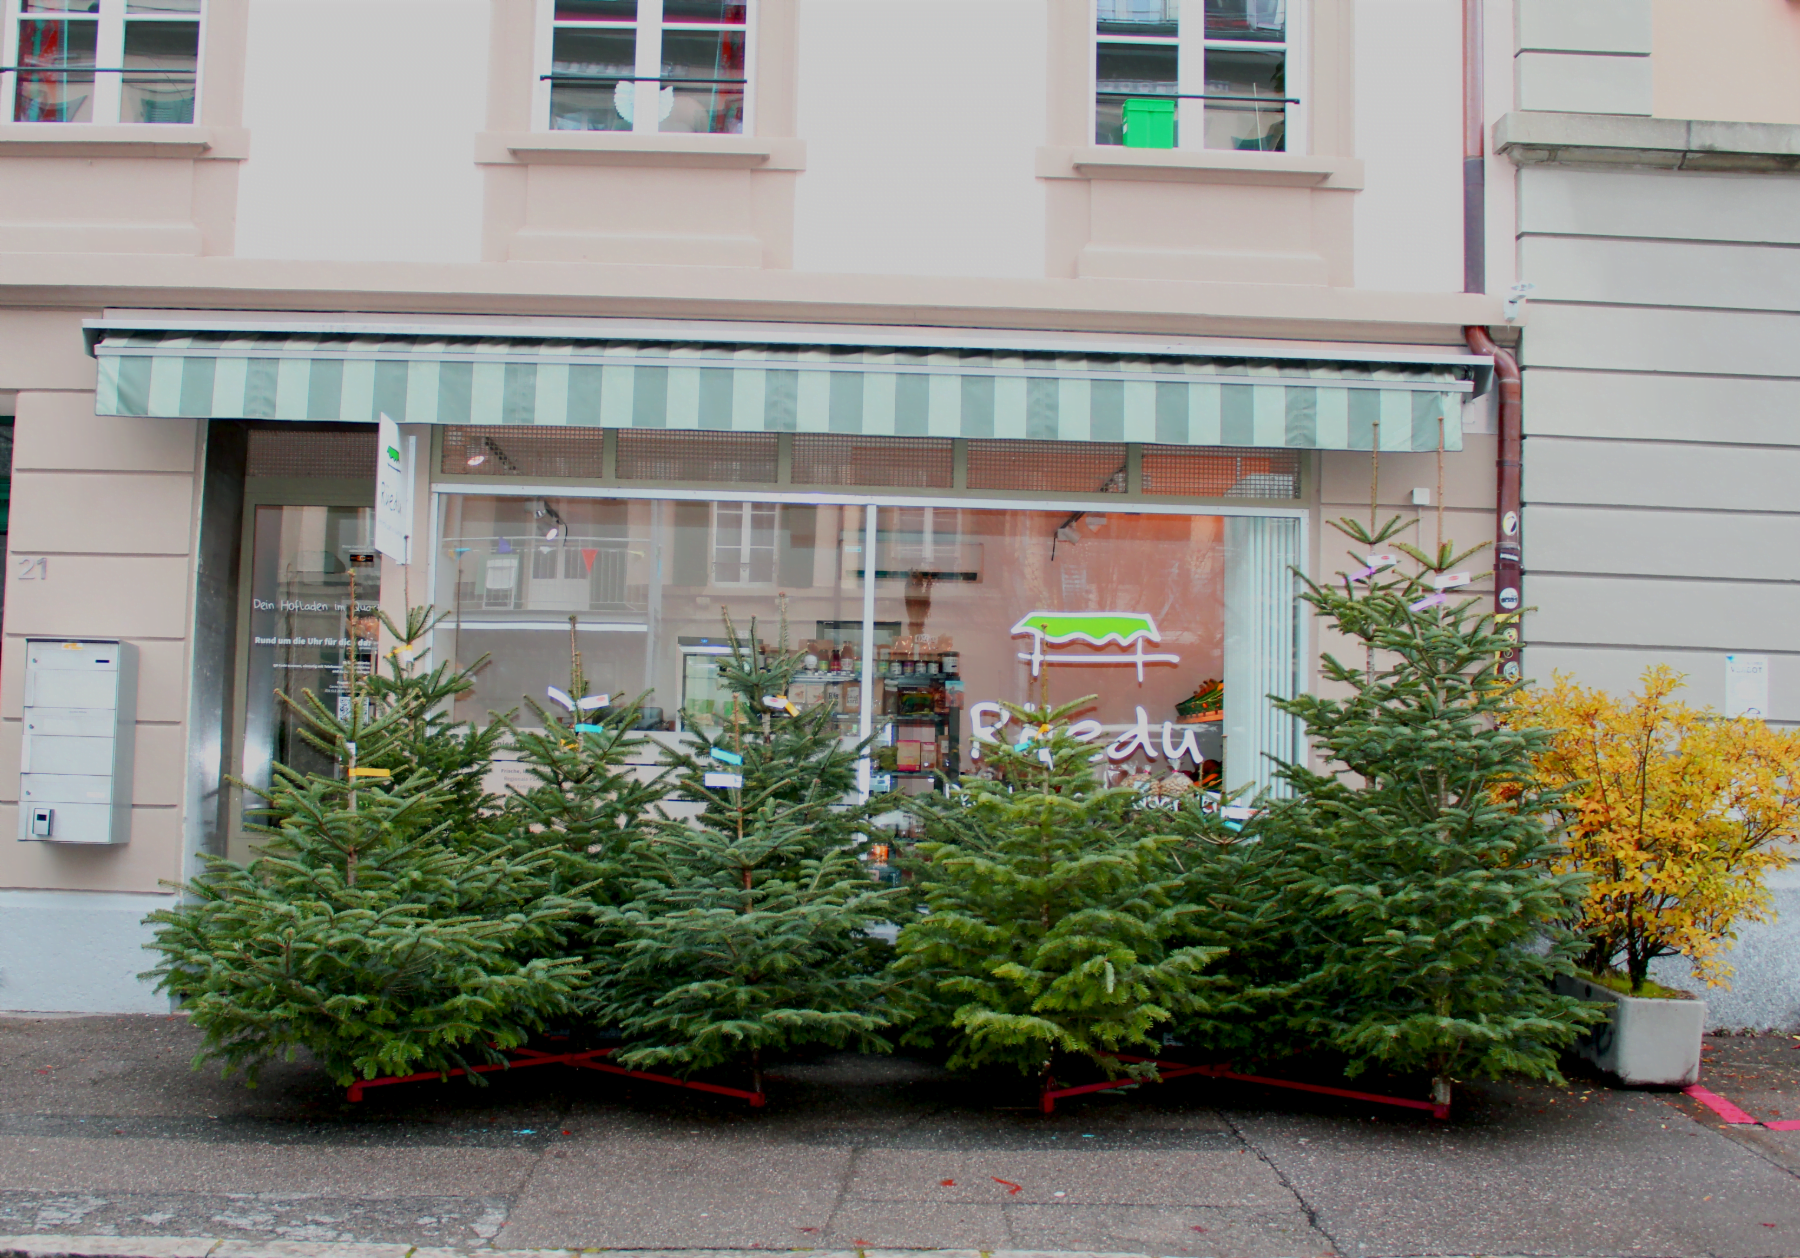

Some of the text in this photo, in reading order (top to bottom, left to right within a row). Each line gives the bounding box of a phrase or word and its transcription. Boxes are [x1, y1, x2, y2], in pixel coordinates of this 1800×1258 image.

[18, 557, 47, 580] 21
[253, 599, 275, 610] Dein
[280, 599, 328, 612] Hofladen
[334, 601, 346, 611] im
[254, 637, 276, 645] Rund
[293, 637, 306, 646] die
[308, 637, 323, 646] Uhr
[324, 637, 337, 646] für
[338, 638, 355, 646] dic
